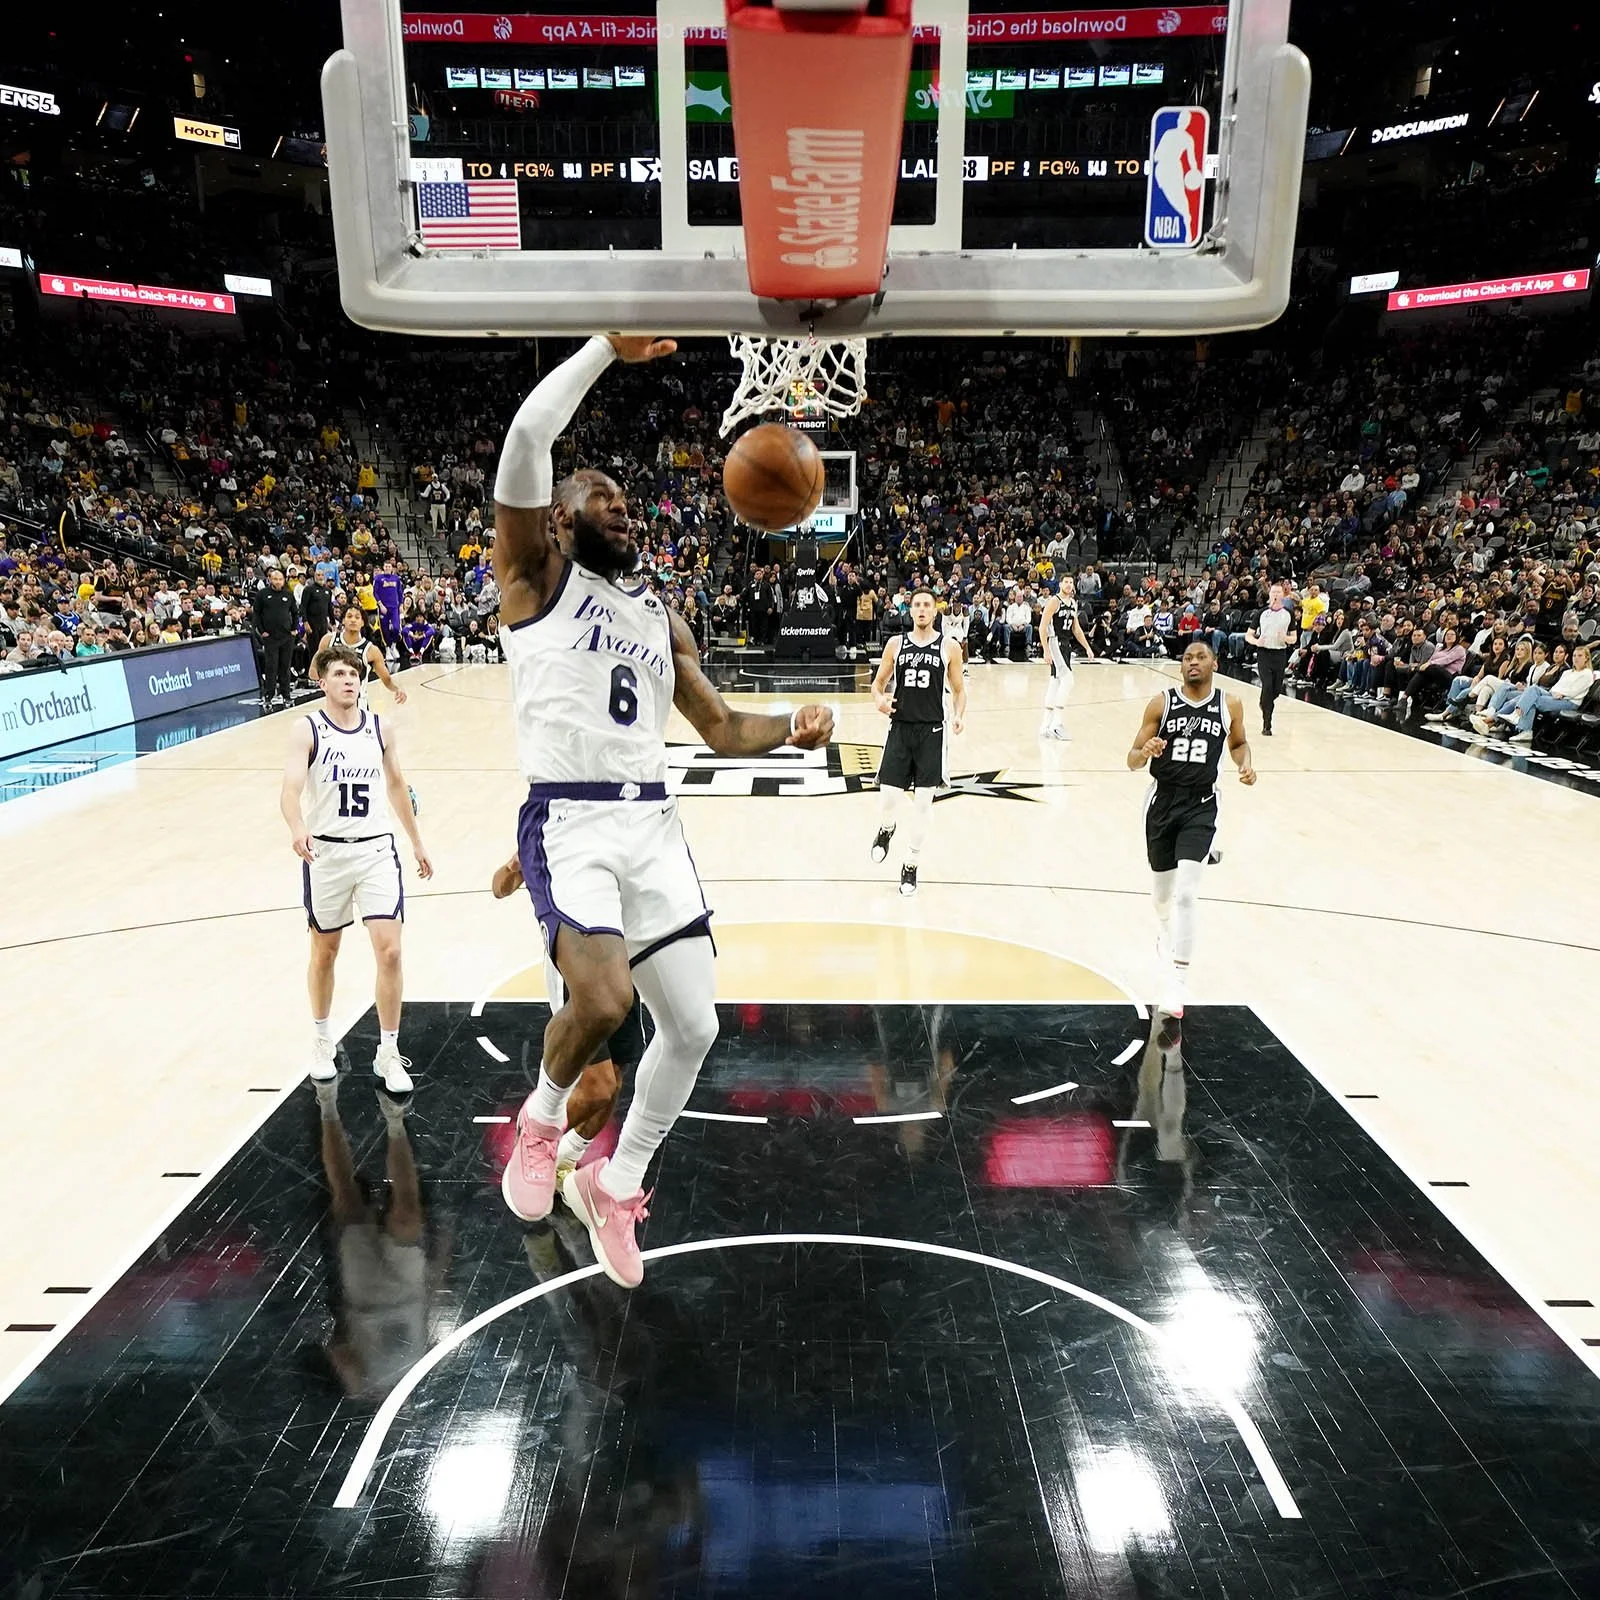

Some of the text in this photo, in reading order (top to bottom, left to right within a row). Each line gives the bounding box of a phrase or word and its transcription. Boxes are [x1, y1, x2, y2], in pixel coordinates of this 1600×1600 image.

[0, 90, 52, 113] ENS5
[184, 125, 220, 139] HOLT
[1381, 113, 1469, 142] DOCUMATION
[466, 162, 493, 178] TO
[513, 162, 555, 178] FG%
[590, 162, 614, 177] PF
[689, 159, 716, 180] SA
[902, 158, 938, 179] LAL
[991, 161, 1016, 176] PF
[1039, 160, 1080, 176] FG%
[1114, 160, 1140, 175] TO
[1154, 216, 1181, 239] NBA
[72, 281, 121, 297] Download
[121, 287, 137, 298] the
[189, 295, 207, 307] App
[1416, 290, 1461, 303] Download
[1463, 287, 1479, 298] the
[1534, 279, 1554, 290] App
[780, 626, 831, 636] ticketmaster
[149, 667, 193, 696] Orchard
[904, 668, 930, 688] 23
[608, 663, 638, 727] 6
[1171, 738, 1208, 764] 22
[338, 783, 369, 817] 15
